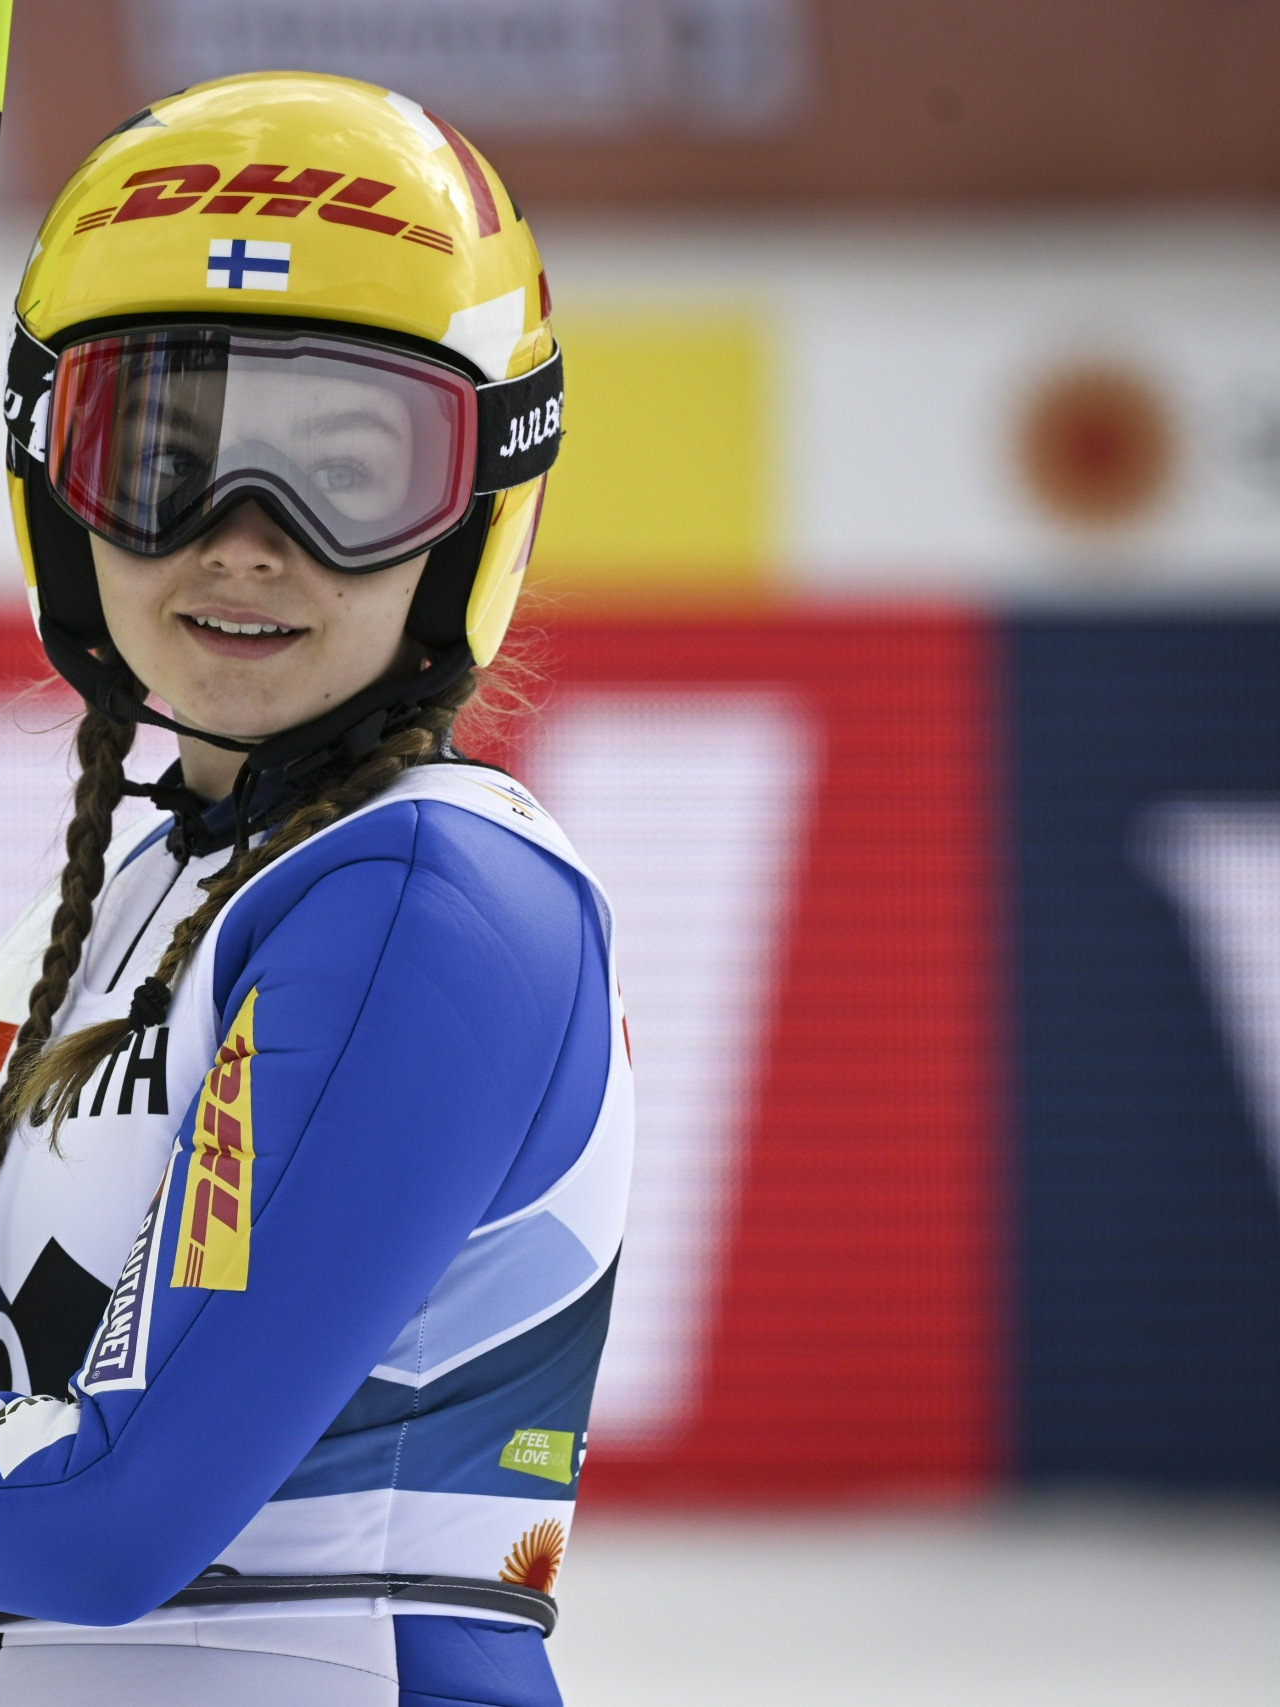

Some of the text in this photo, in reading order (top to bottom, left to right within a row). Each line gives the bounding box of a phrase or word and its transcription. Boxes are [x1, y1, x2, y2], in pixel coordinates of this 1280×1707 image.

[111, 164, 410, 237] DHL
[500, 391, 563, 458] JULB
[190, 1034, 242, 1247] DHL
[519, 1432, 550, 1449] FEEL
